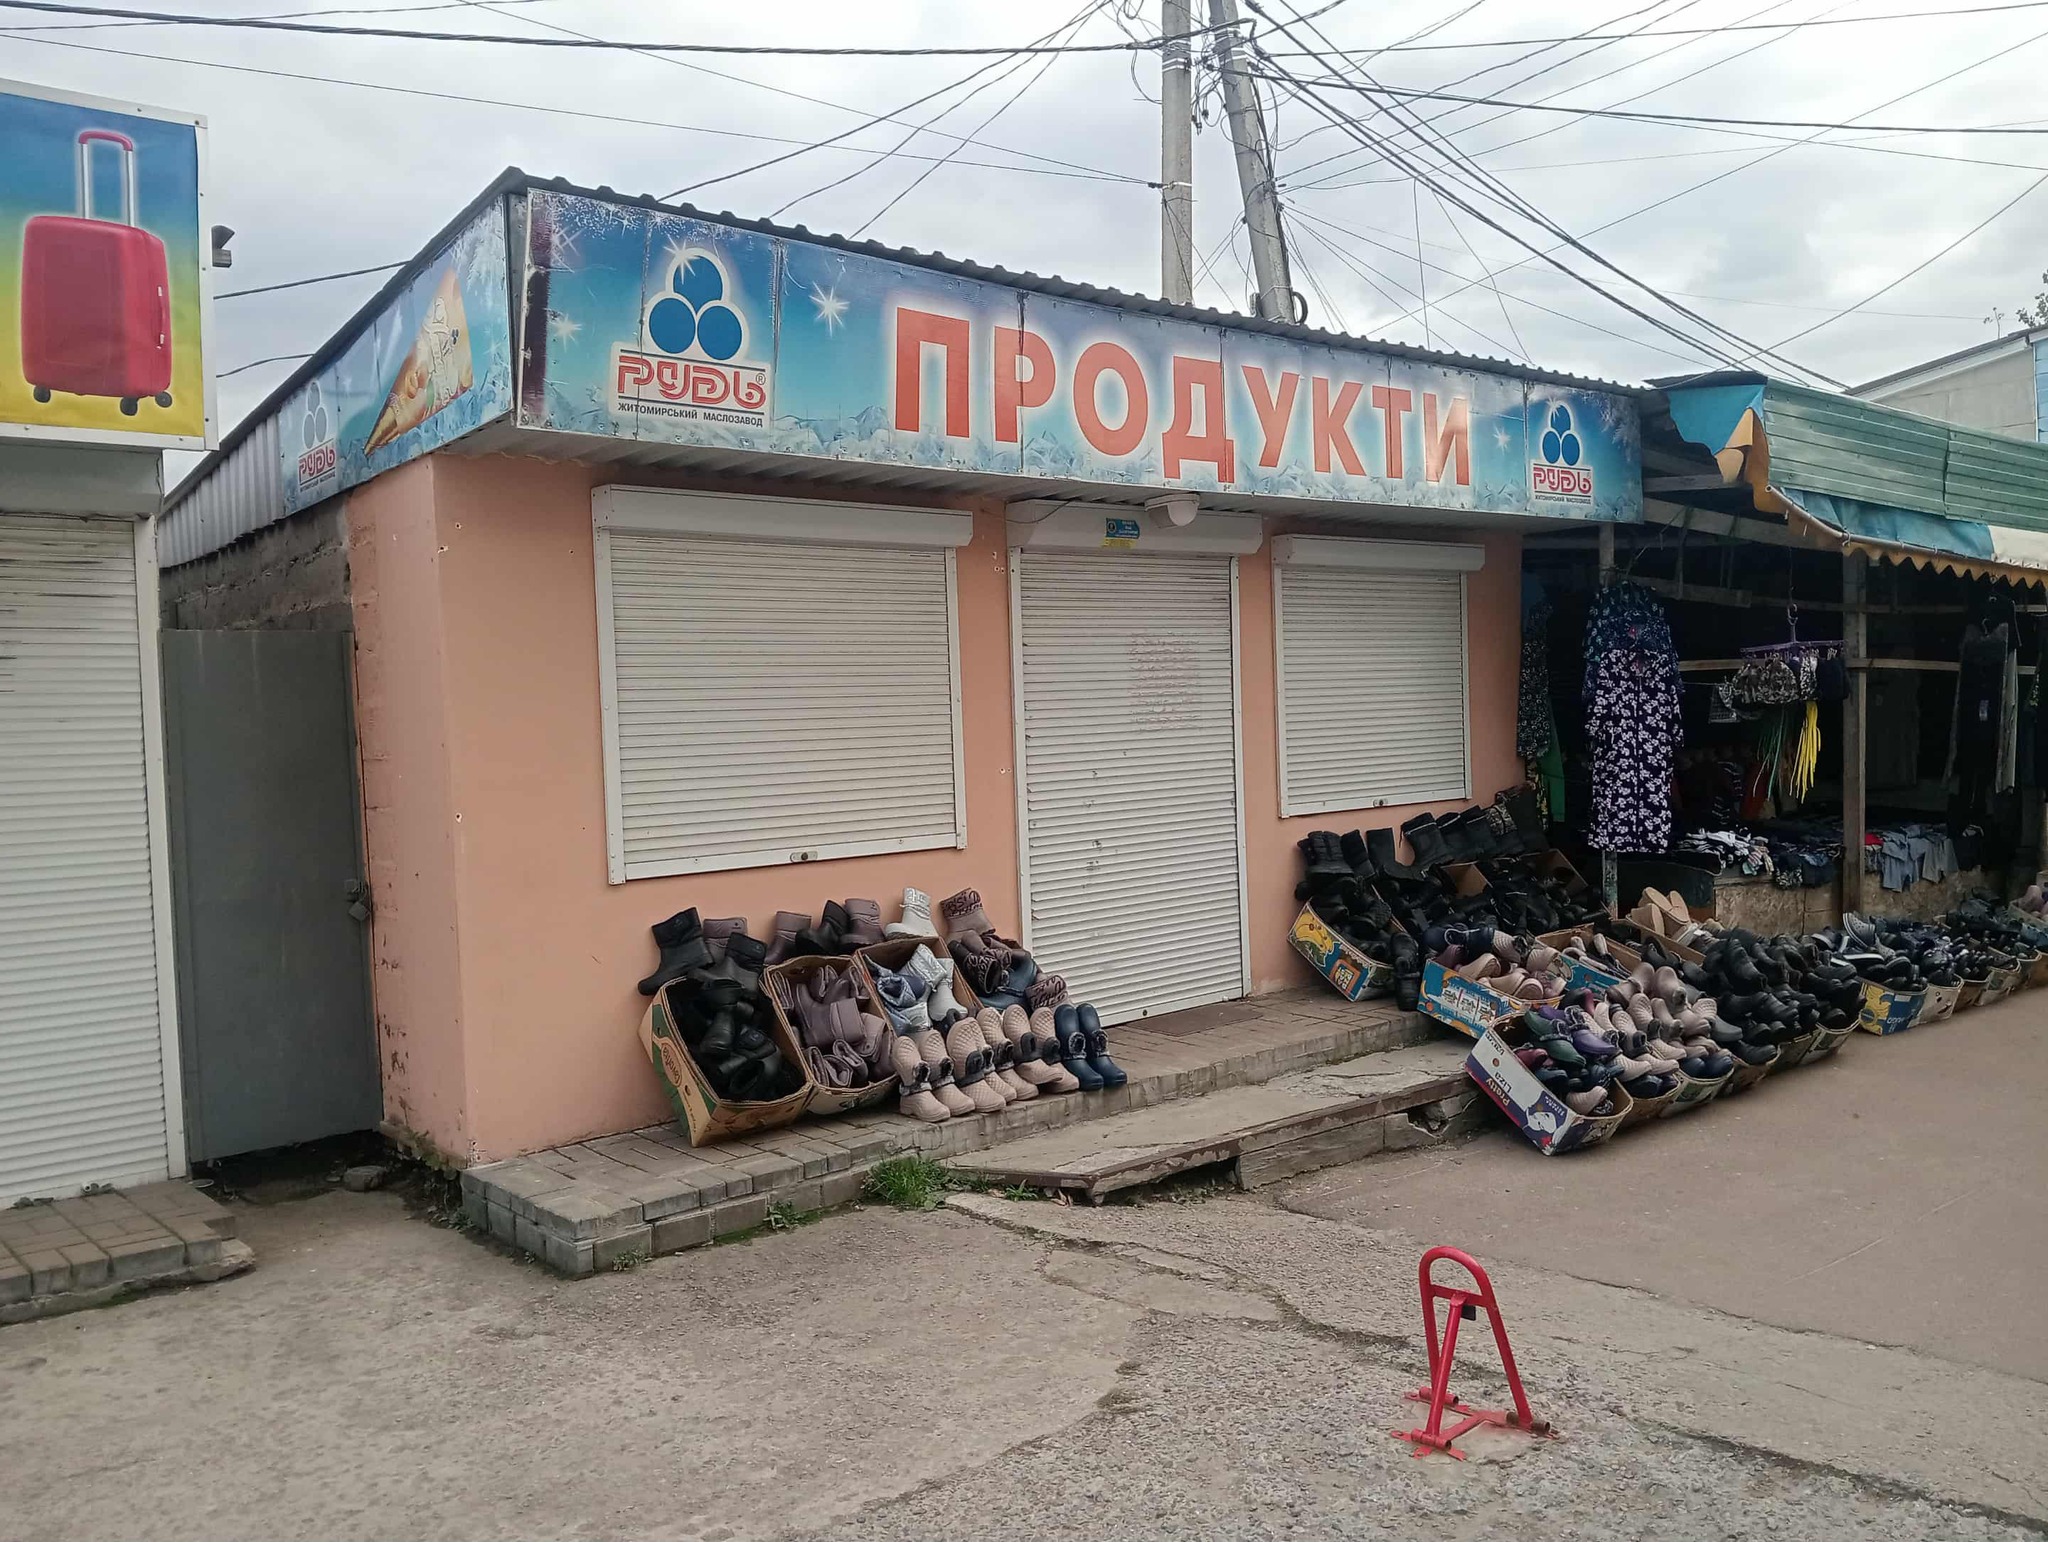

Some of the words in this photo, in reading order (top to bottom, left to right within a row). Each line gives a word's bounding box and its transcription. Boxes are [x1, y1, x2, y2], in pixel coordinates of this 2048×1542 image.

[895, 306, 1470, 486] ПРОДУКТИ
[618, 403, 698, 419] ЖИТОМИРСЬКИЙ
[703, 412, 763, 428] МАСЛОЗАВОД
[1485, 1077, 1511, 1106] Pretty
